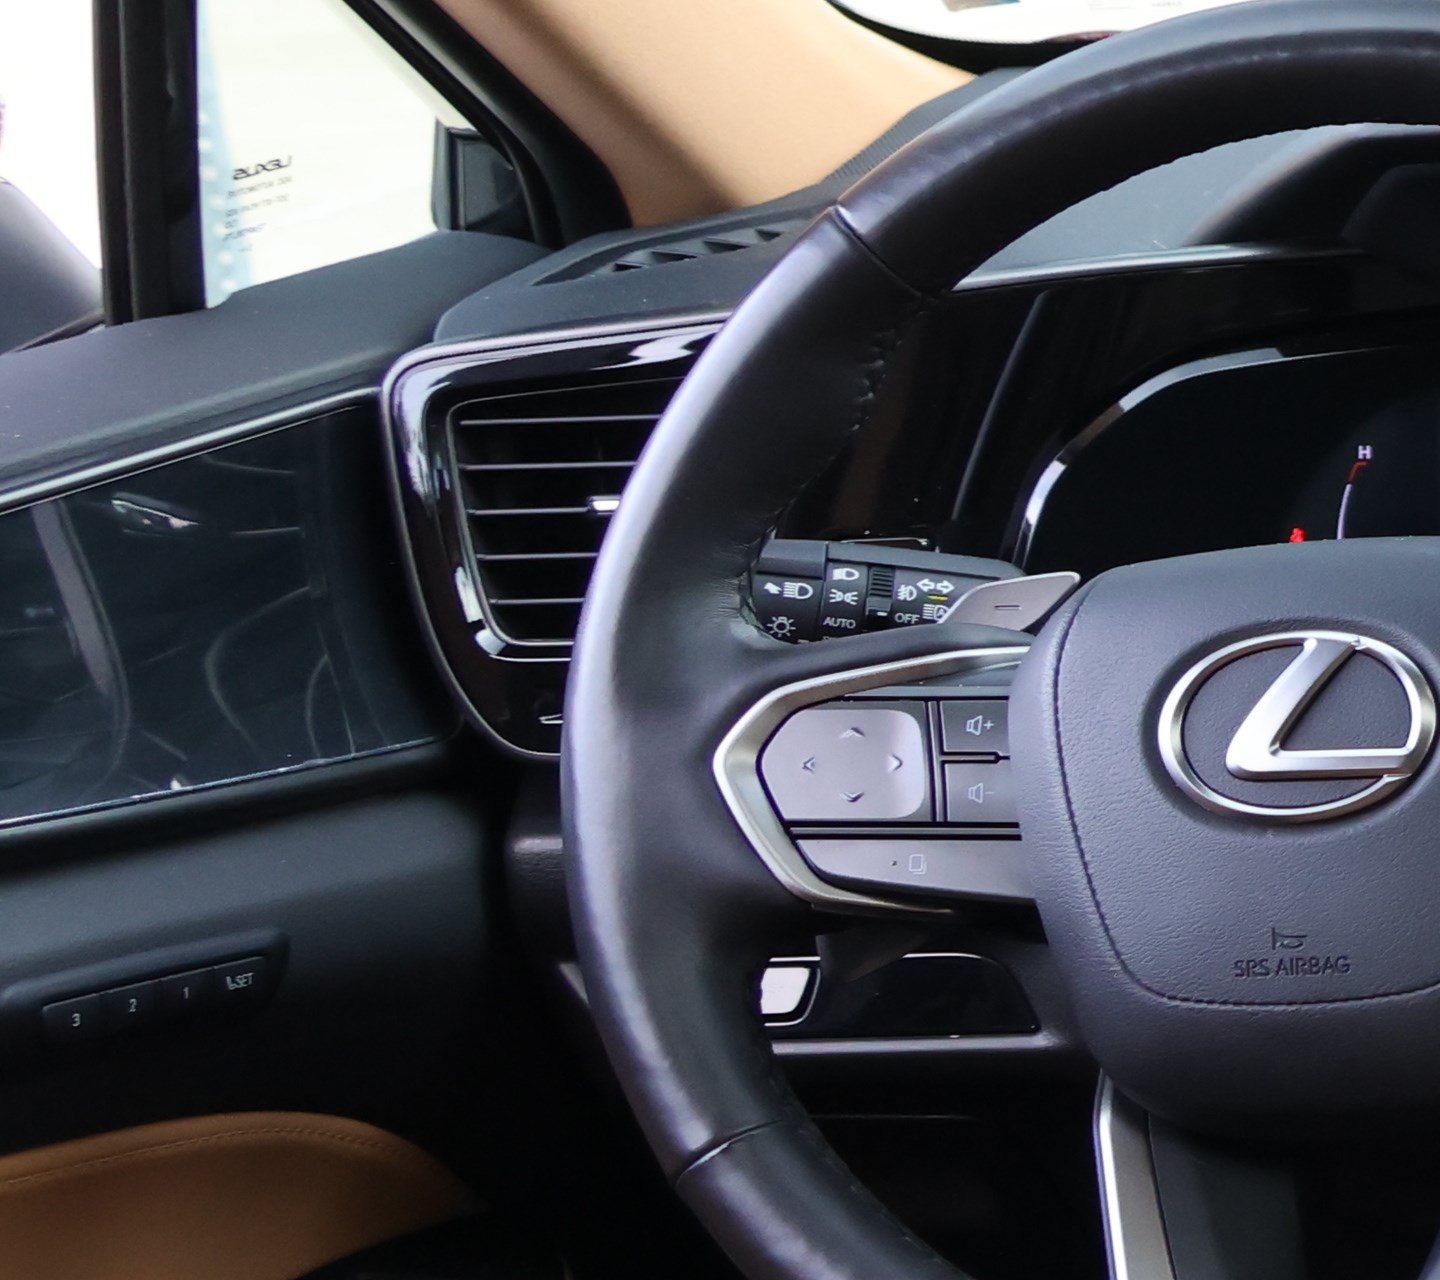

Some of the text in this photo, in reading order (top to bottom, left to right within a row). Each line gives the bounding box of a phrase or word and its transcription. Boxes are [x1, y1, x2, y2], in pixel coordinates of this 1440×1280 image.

[1357, 444, 1373, 460] H
[823, 616, 857, 629] AUTO
[894, 612, 921, 625] OFF
[1232, 955, 1352, 978] SRS AIRBAG
[235, 972, 255, 988] SET
[182, 986, 190, 1000] 1
[128, 998, 138, 1014] 2
[71, 1012, 82, 1028] 3
